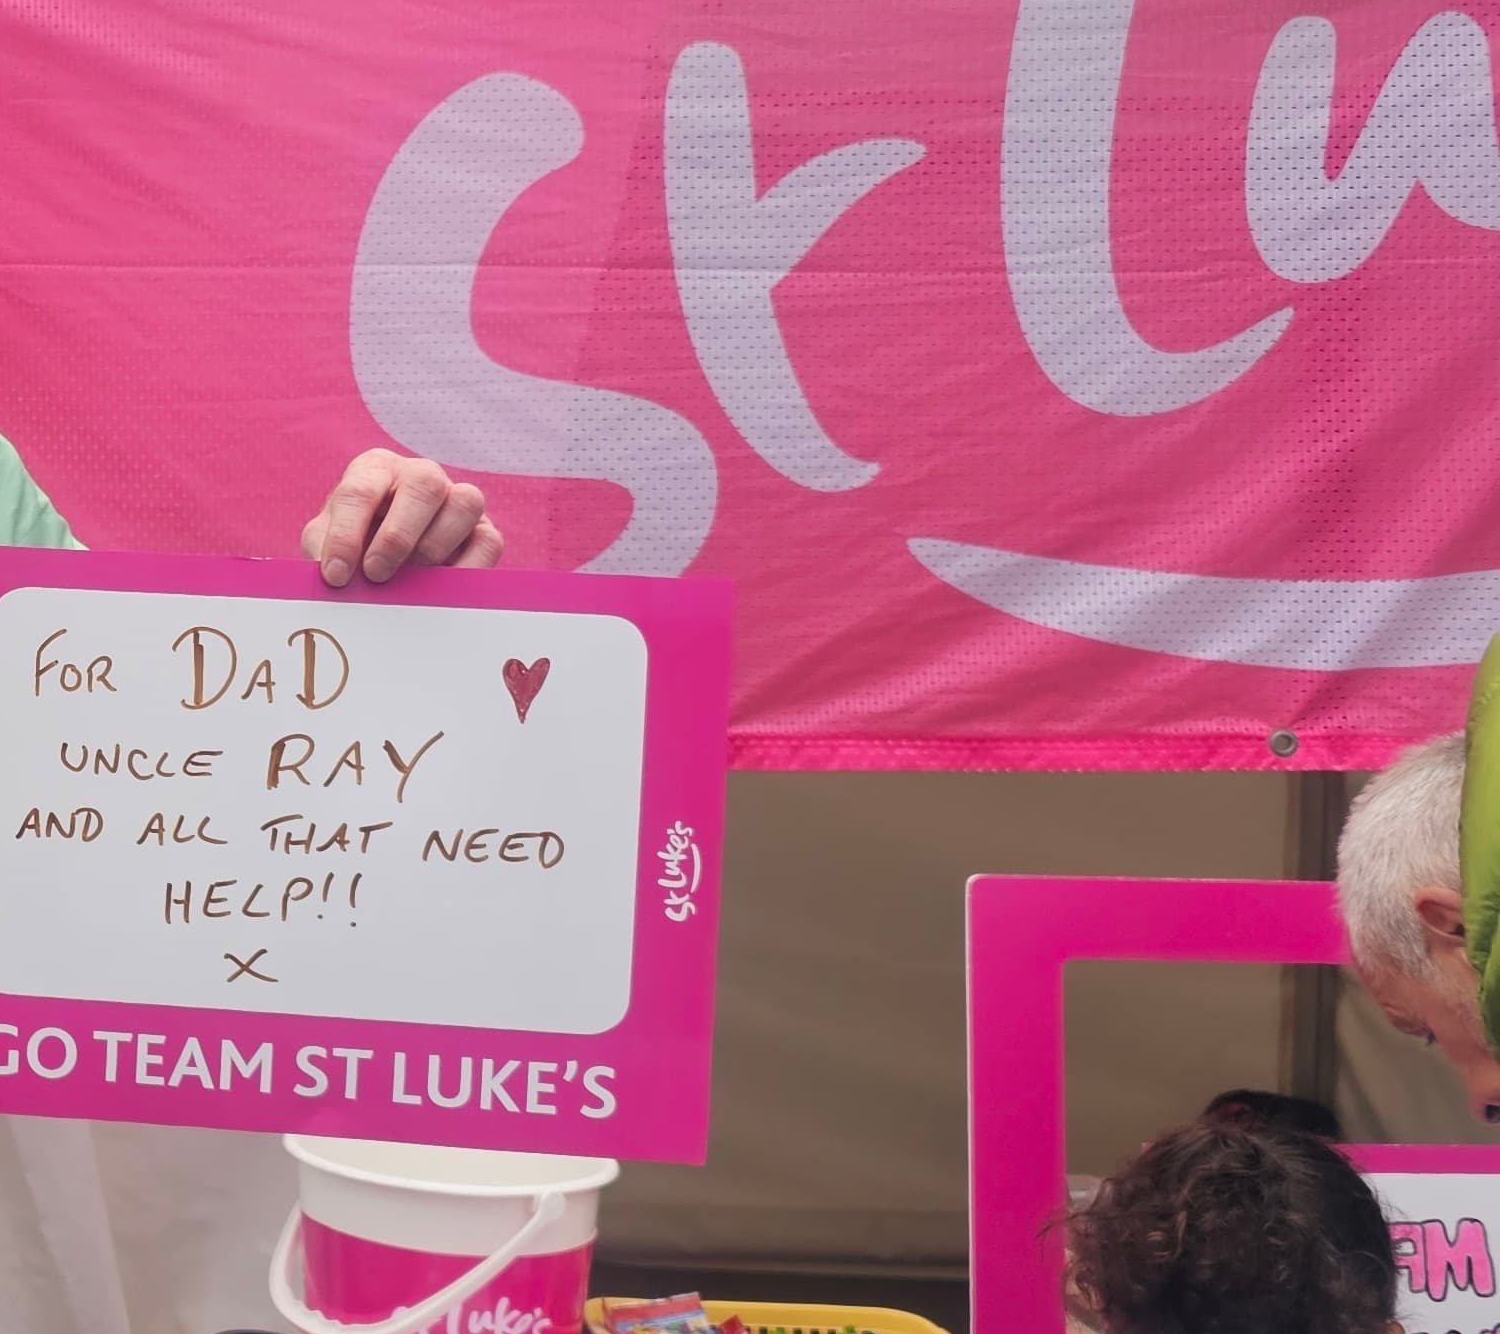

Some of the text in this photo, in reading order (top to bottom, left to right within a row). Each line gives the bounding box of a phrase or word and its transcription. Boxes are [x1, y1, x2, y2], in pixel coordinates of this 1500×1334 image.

[32, 628, 117, 699] FOR
[59, 730, 444, 803] UNCLE RAY
[15, 808, 565, 870] AND ALL THAT NEED
[656, 820, 696, 922] St Luke's
[163, 872, 360, 929] HELP!!
[92, 1030, 275, 1094] TEAM
[292, 1045, 374, 1101] ST
[392, 1051, 617, 1119] LUKE'S
